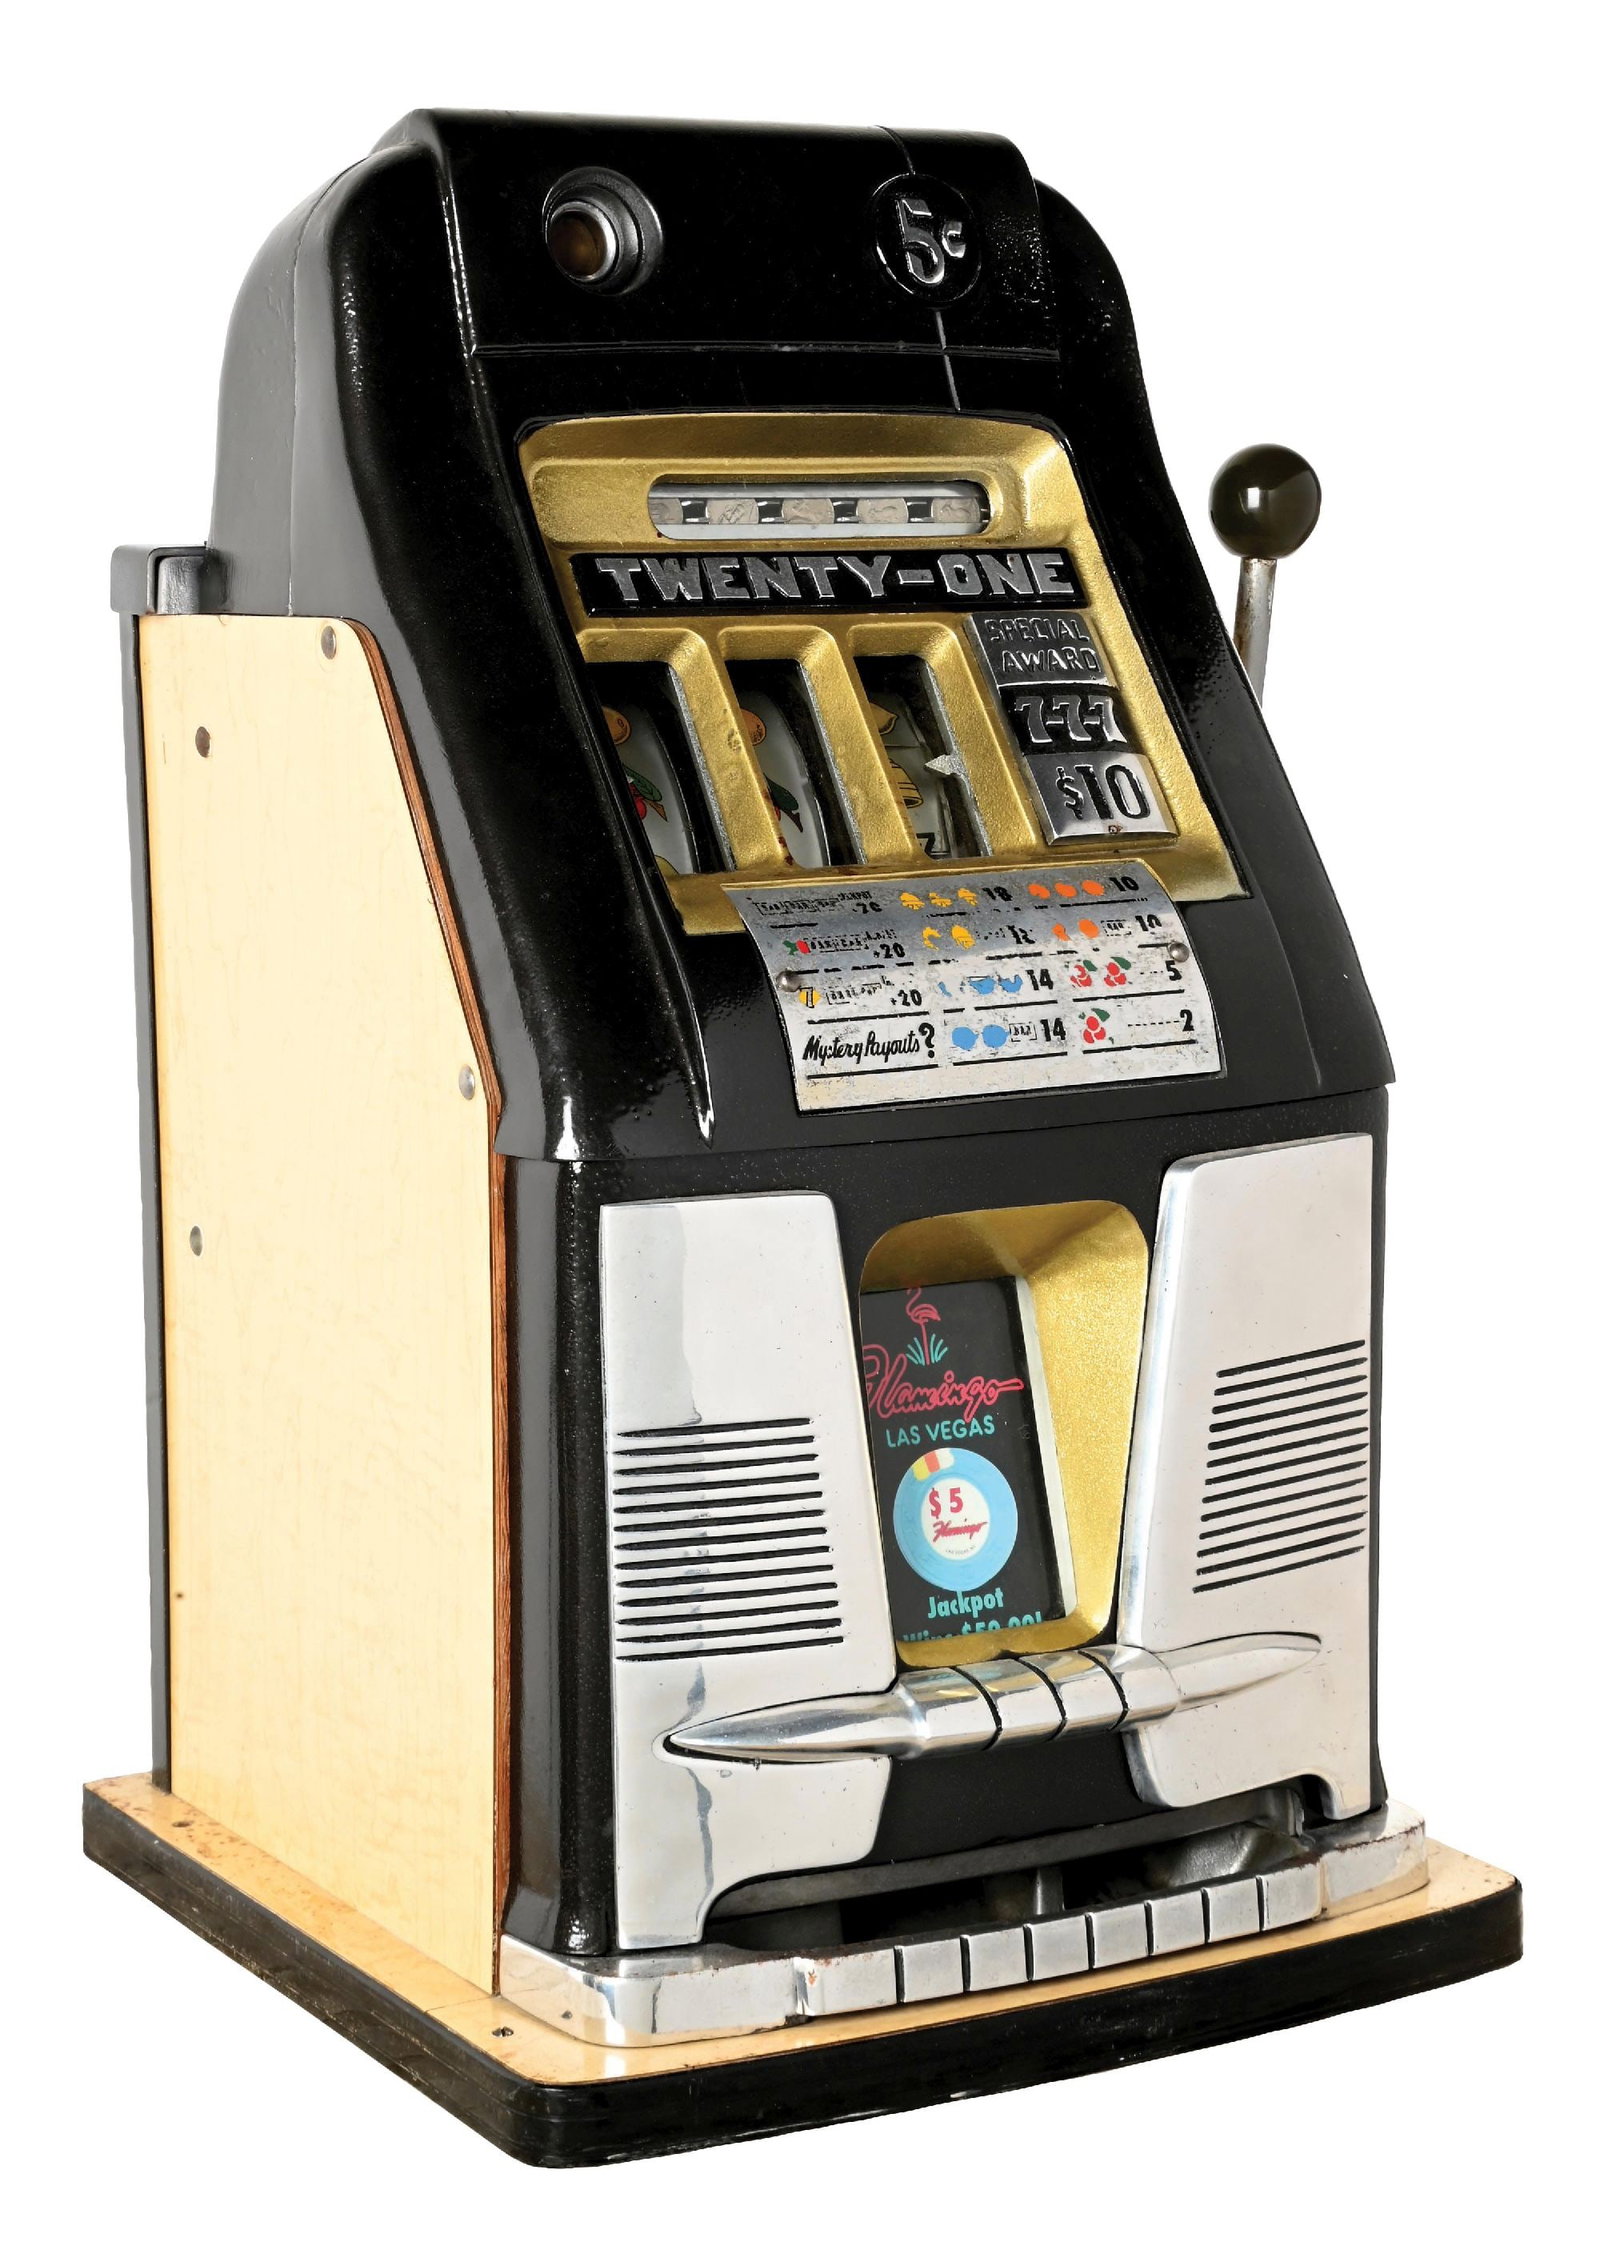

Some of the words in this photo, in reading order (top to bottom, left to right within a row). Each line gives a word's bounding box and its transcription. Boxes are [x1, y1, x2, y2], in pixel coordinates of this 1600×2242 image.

[595, 552, 1078, 602] TWENTY-ONE
[984, 617, 1091, 643] SPECIAL
[1001, 646, 1102, 674] AWARD
[1055, 763, 1151, 820] $10
[1109, 876, 1140, 892] 10
[1026, 968, 1054, 991] 14
[1165, 960, 1183, 982] 5
[1040, 1017, 1067, 1042] 14
[1179, 1009, 1195, 1032] 2
[886, 1425, 921, 1448] LAS
[926, 1414, 996, 1441] VEGAS
[927, 1587, 1005, 1619] Jackpot
